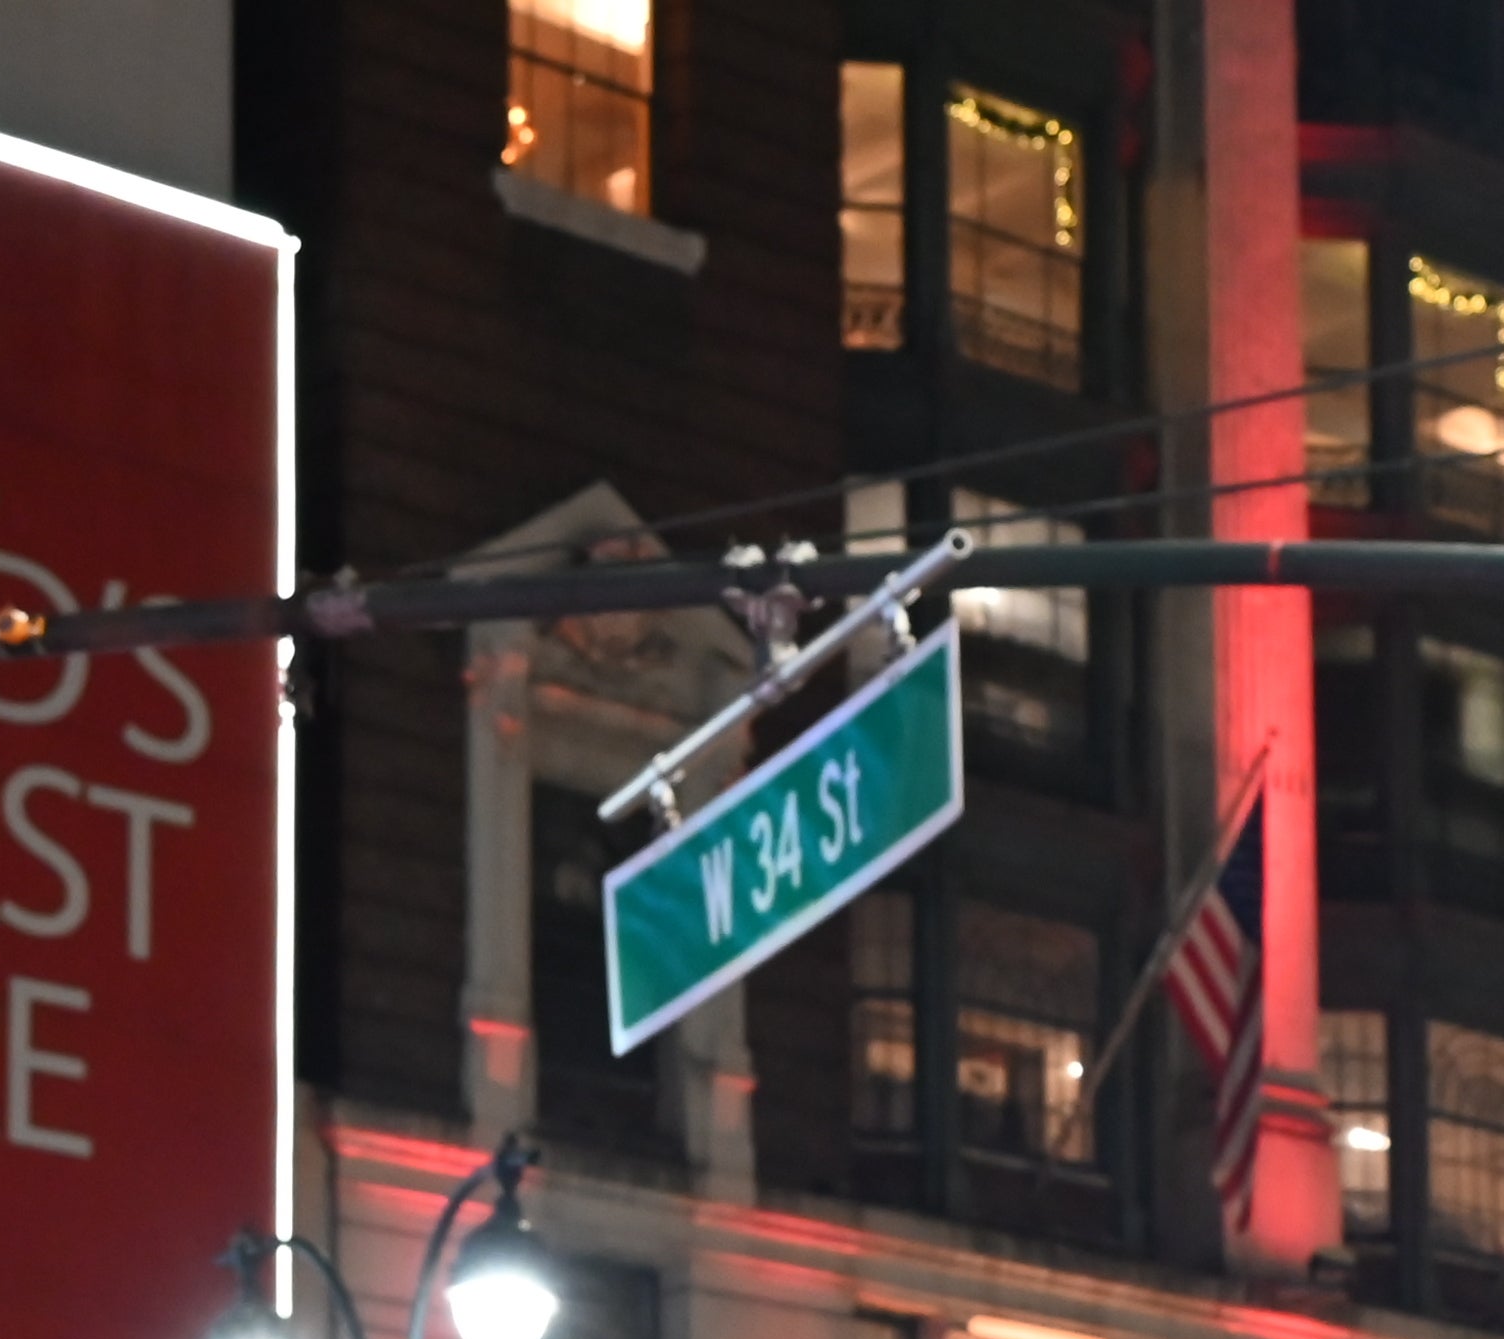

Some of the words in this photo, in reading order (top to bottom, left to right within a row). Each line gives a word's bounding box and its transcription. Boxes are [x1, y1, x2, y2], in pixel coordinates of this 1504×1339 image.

[701, 838, 733, 945] W
[750, 792, 802, 914] 34
[819, 749, 865, 863] St
